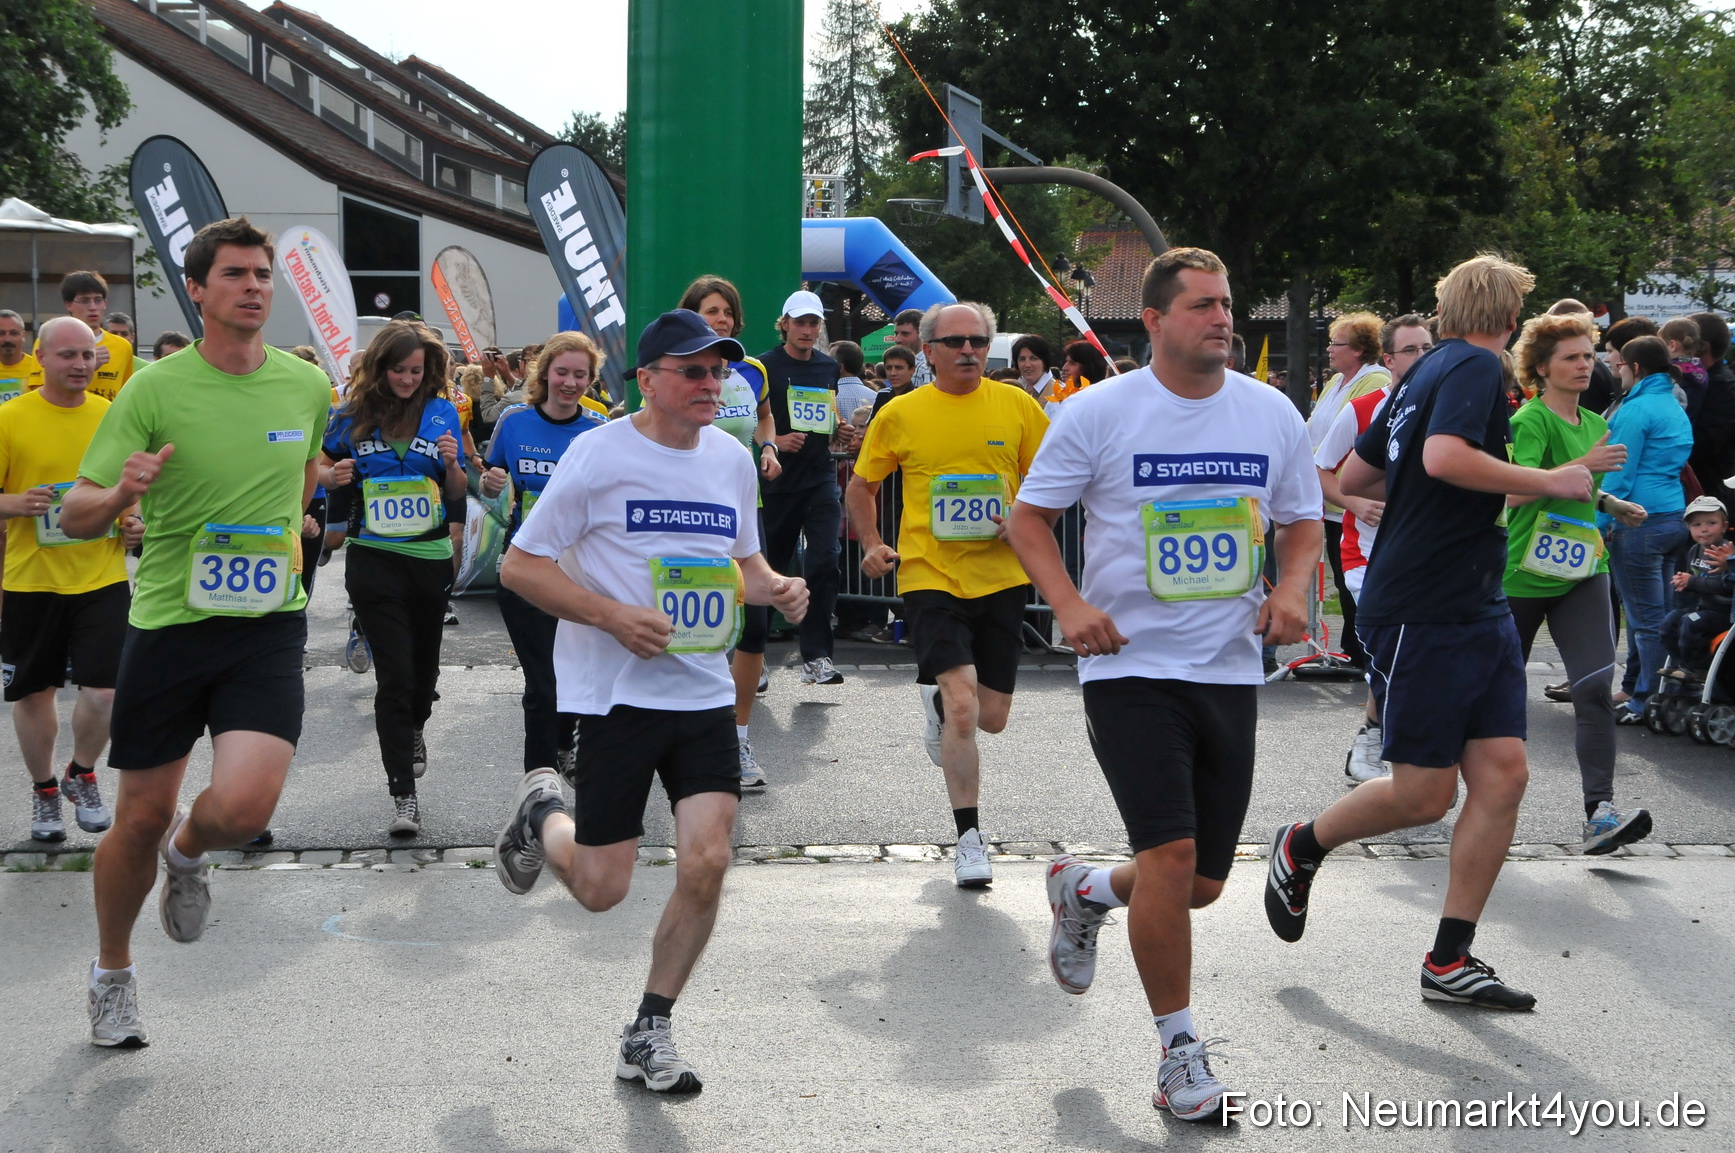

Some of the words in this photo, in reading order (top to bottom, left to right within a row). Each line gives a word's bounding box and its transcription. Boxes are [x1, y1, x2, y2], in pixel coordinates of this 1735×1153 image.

[715, 405, 751, 418] OCK
[793, 402, 826, 422] 555
[519, 445, 552, 454] TEAM
[518, 459, 557, 476] BO
[1156, 461, 1262, 478] STAEDTLER
[368, 496, 431, 521] 1080
[934, 497, 1001, 522] 1280
[381, 520, 402, 529] Carina
[649, 509, 732, 530] STAEDTLER
[1158, 532, 1238, 575] 899
[1534, 534, 1586, 568] 839
[199, 555, 278, 595] 386
[1172, 575, 1210, 585] Michael
[208, 593, 248, 604] Matthias
[662, 591, 725, 629] 900
